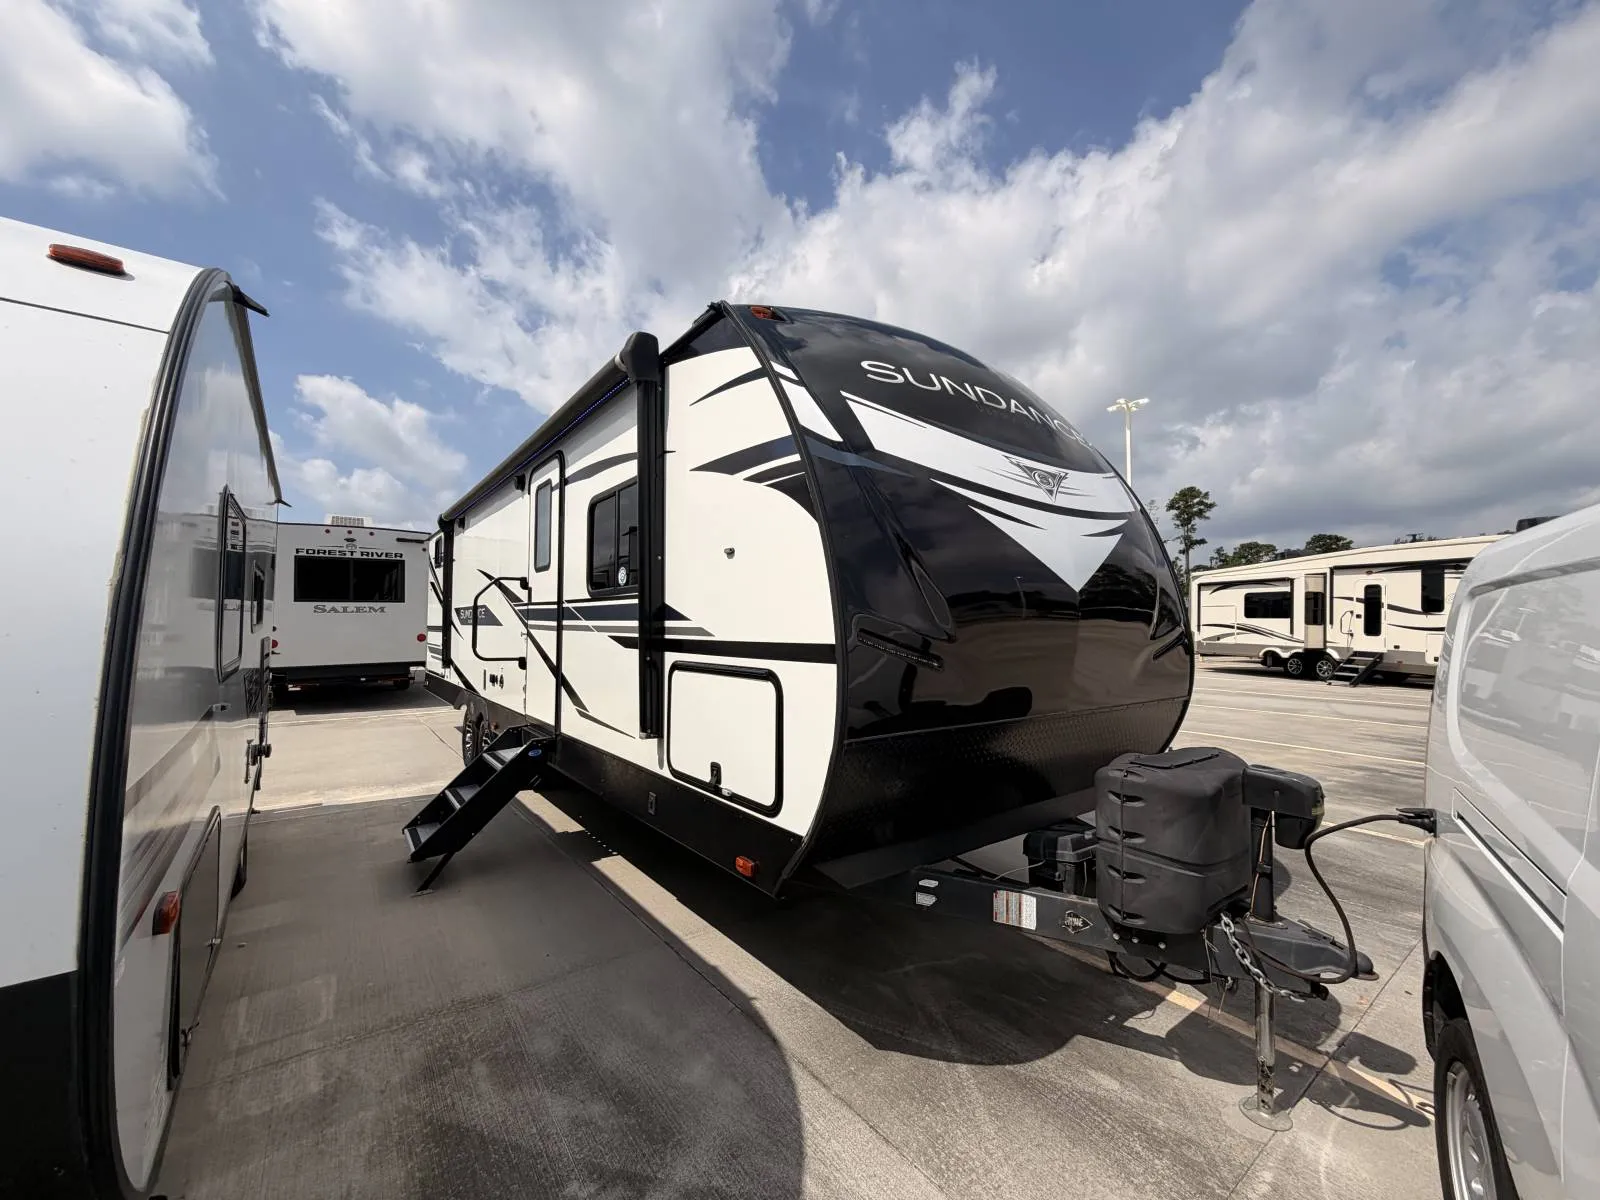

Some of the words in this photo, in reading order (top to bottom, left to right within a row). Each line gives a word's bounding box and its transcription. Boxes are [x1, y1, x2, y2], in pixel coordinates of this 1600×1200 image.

[295, 549, 357, 557] FOREST
[360, 551, 403, 559] RIVER
[313, 604, 386, 614] SALEM
[460, 607, 486, 619] SUNDCE
